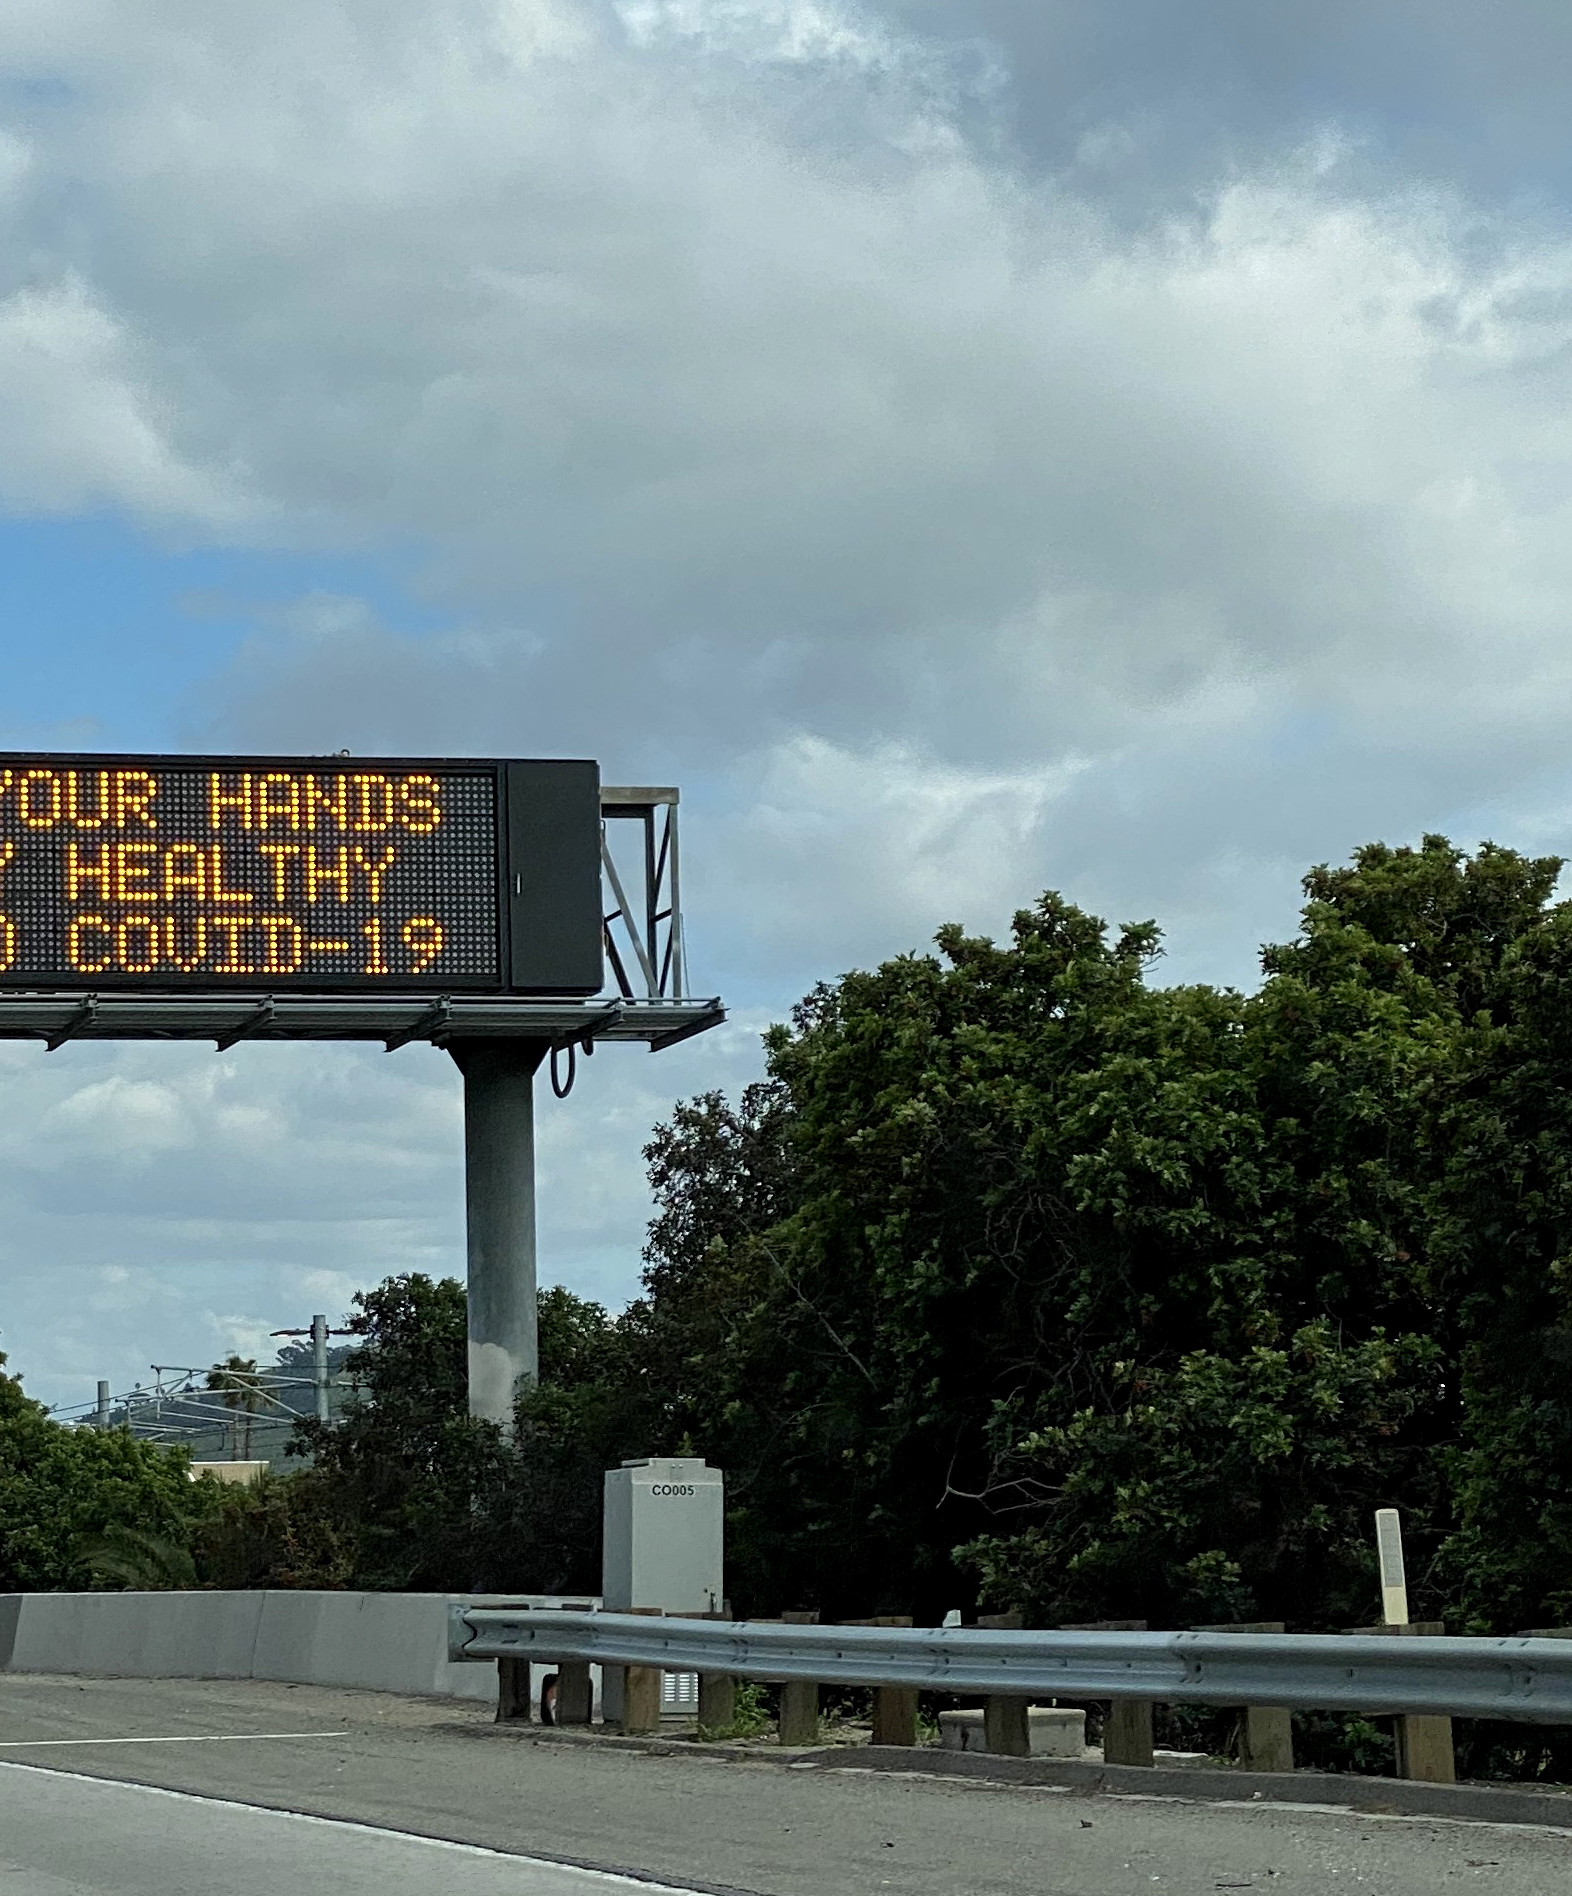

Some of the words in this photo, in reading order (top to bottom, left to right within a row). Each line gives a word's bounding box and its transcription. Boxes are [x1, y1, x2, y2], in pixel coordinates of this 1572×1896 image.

[210, 772, 442, 832] HANDS
[69, 842, 396, 902] HEALTHY
[69, 915, 444, 975] COVID-19
[652, 1484, 695, 1496] CO005
